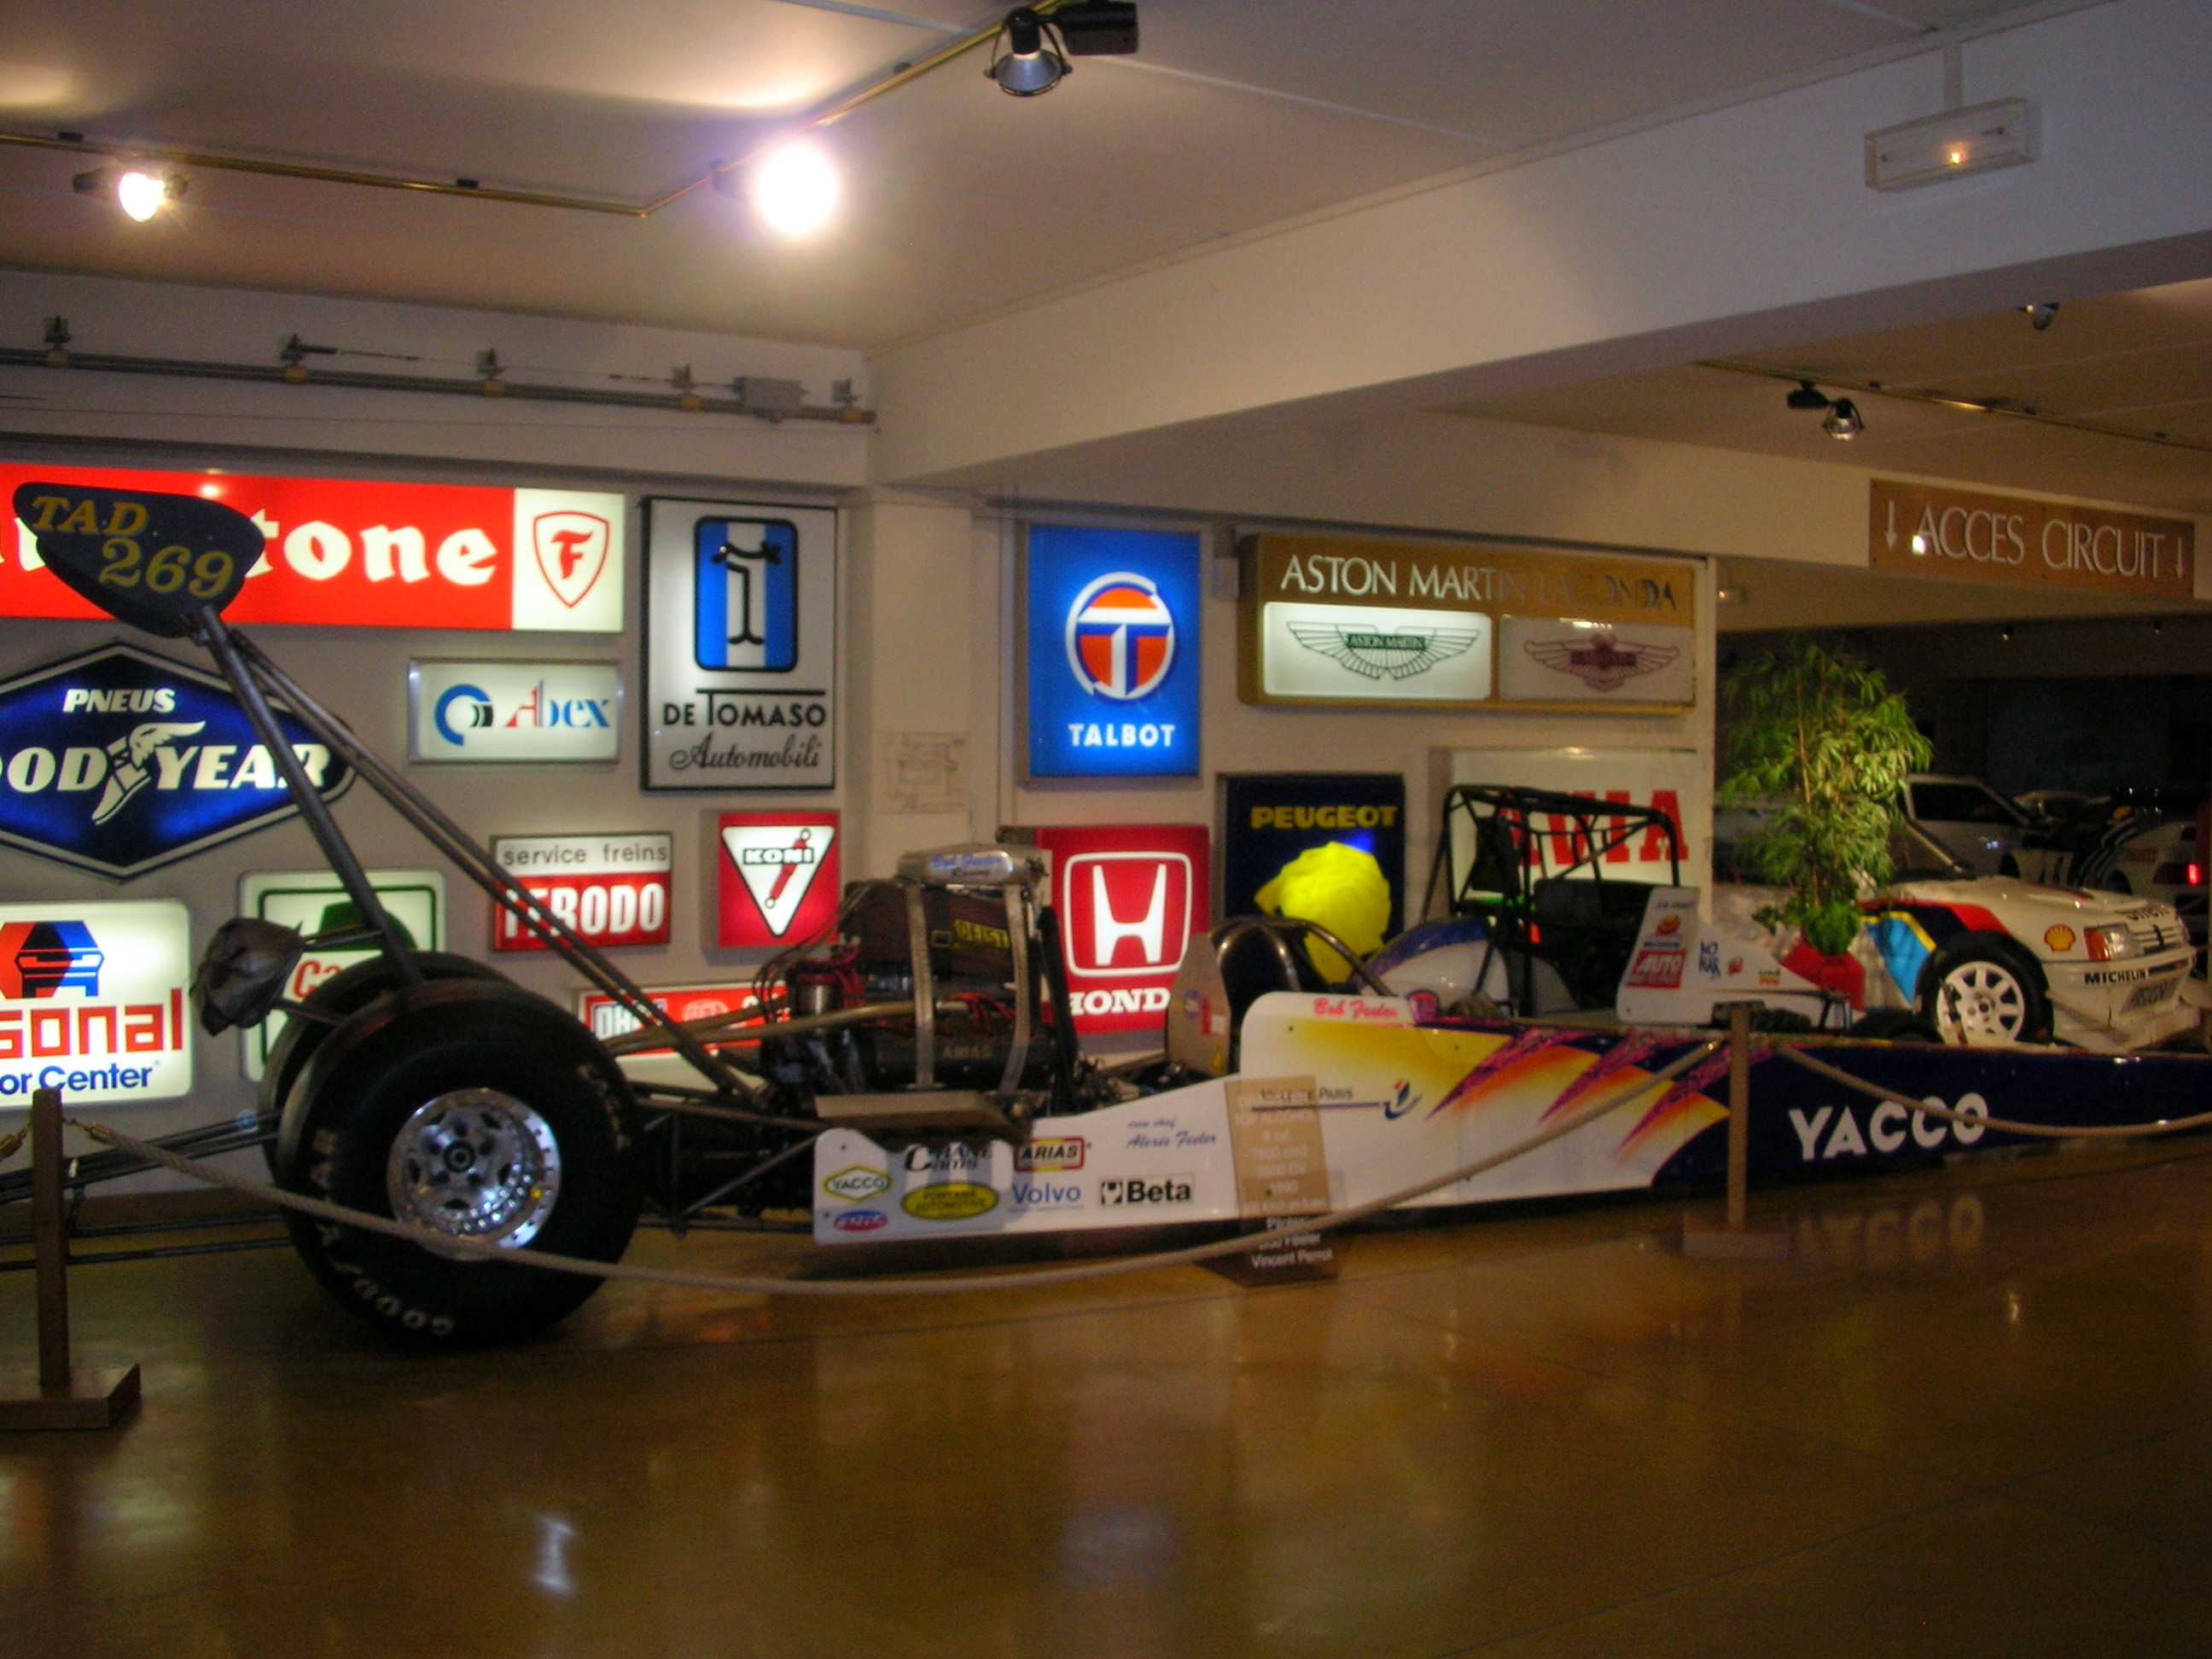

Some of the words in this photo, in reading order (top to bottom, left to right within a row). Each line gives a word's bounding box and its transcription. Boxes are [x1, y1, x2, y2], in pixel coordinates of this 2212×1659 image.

[32, 496, 148, 536] TAD
[1913, 504, 2025, 566] ACCES
[2041, 519, 2166, 578] CIRCUIT
[98, 537, 235, 597] 269
[1280, 554, 1396, 596] ASTON
[1408, 562, 1527, 602] MARTIN
[1349, 635, 1382, 648] ASTON
[1385, 637, 1423, 649] MARTIN
[61, 688, 176, 713] PNEUS
[663, 703, 695, 726] DE
[1067, 723, 1176, 748] TALBOT
[669, 731, 823, 770] Automobili
[1250, 805, 1398, 830] PEUGEOT
[504, 844, 587, 865] service
[602, 842, 668, 862] freins
[744, 848, 814, 864] KONI
[2084, 969, 2146, 985] MICHELIN
[1068, 987, 1171, 1016] OND
[38, 1062, 153, 1091] Center
[1788, 1091, 1989, 1161] YACCO
[1021, 1144, 1079, 1161] ARIAS
[833, 1176, 886, 1190] YACCO
[1012, 1181, 1082, 1205] Volvo
[1127, 1179, 1192, 1203] Beta
